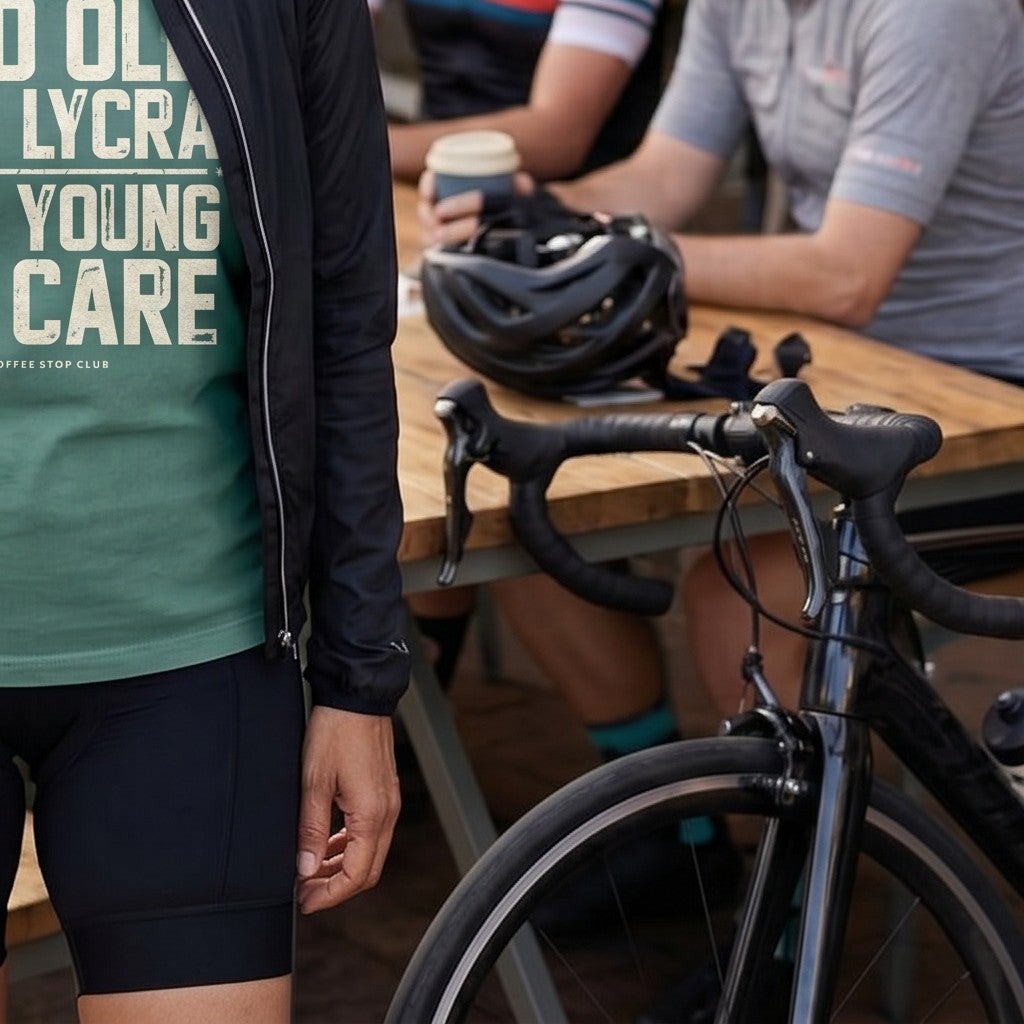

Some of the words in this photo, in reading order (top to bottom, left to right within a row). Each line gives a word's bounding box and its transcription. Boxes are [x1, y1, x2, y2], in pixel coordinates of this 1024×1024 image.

[22, 88, 219, 160] LYCRA
[17, 184, 221, 252] YOUNG
[12, 258, 217, 346] CARE
[39, 360, 72, 370] STOP
[76, 360, 109, 370] CLUB
